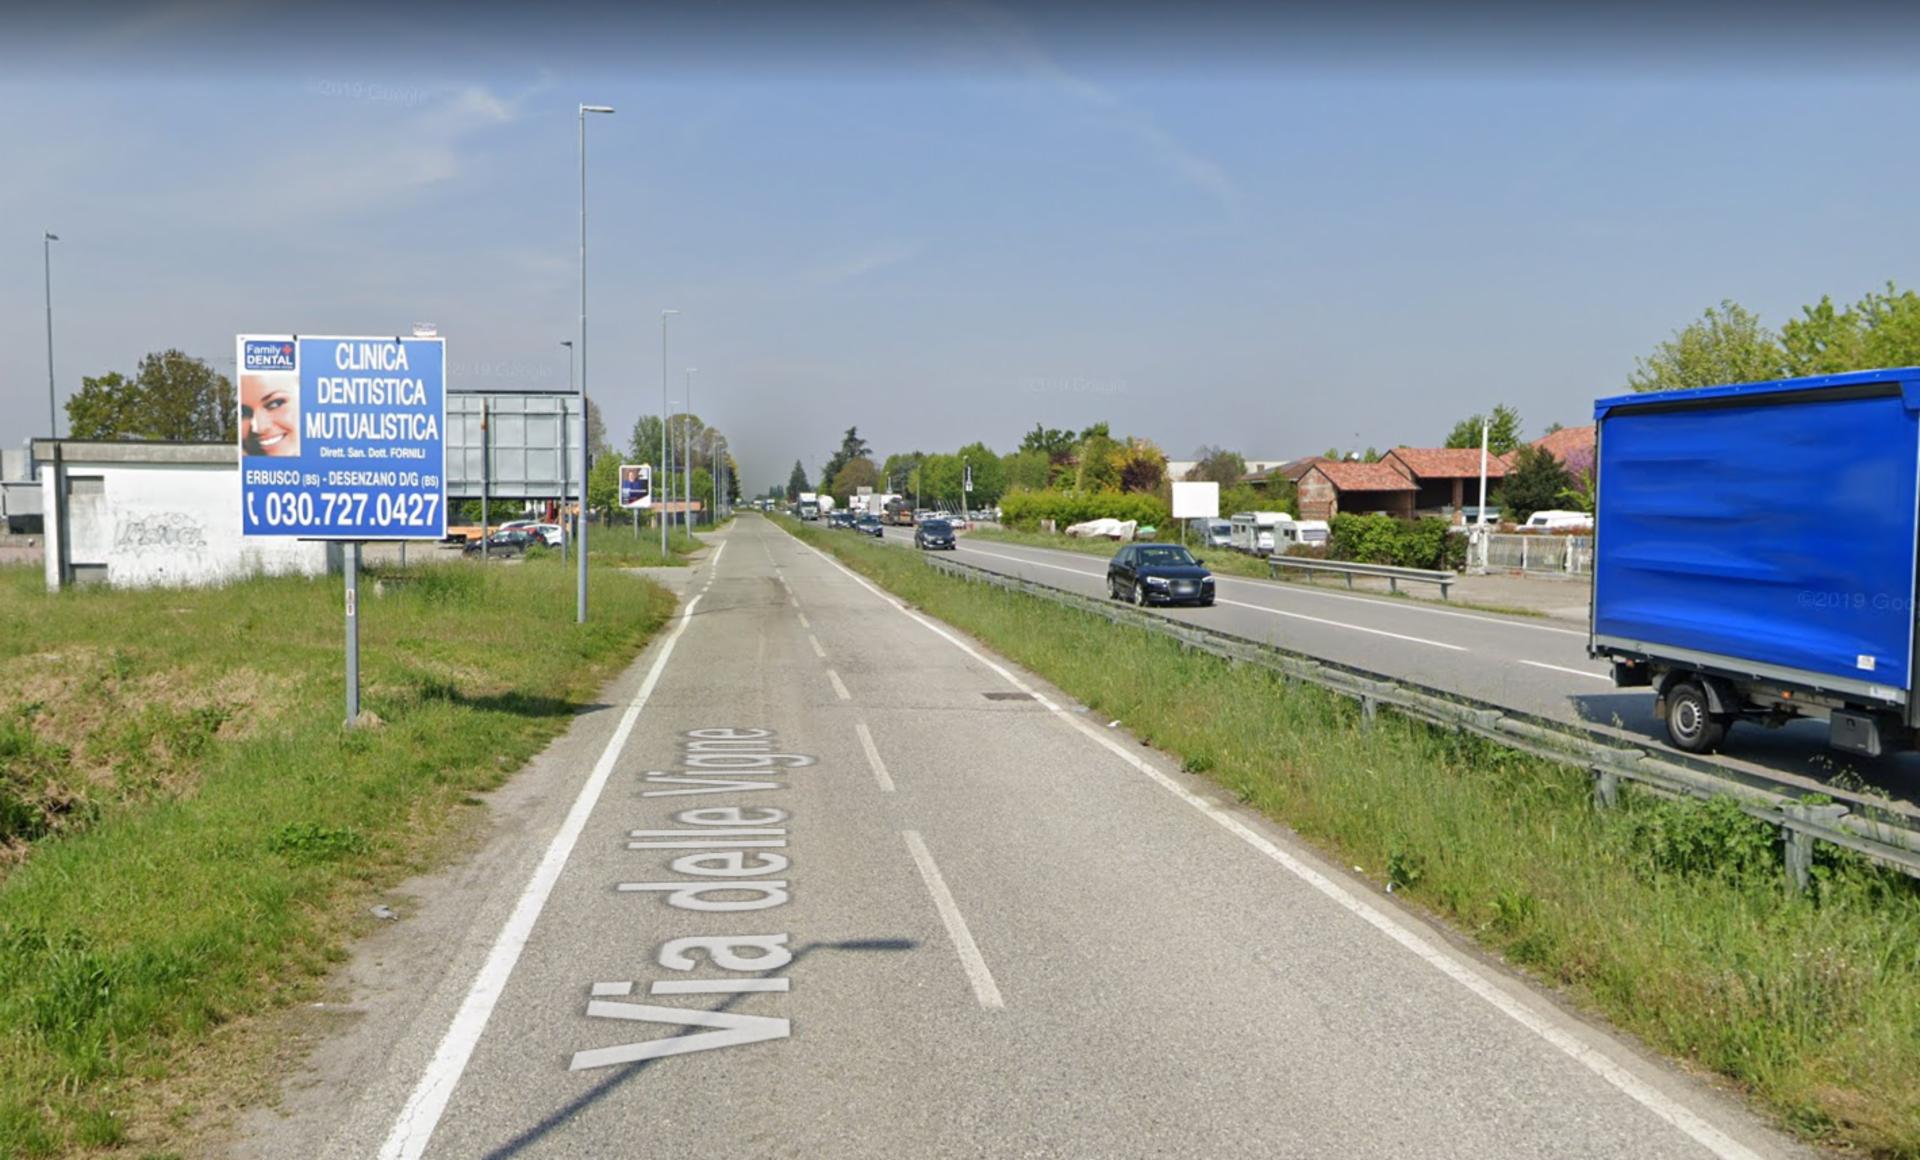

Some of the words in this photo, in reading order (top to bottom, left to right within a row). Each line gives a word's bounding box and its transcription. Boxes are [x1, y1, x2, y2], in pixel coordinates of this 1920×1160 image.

[247, 344, 281, 355] Family
[247, 355, 293, 365] DENTAL
[335, 342, 409, 371] CLINICA
[317, 377, 427, 405] DENTISTICA
[306, 412, 438, 440] MUTUALISTICA
[347, 447, 366, 458] San.
[368, 447, 388, 458] Dott.
[390, 448, 426, 459] FORNILI
[246, 470, 300, 486] ERBUSCO
[302, 473, 320, 488] (BS)
[328, 471, 397, 487] DESENZANO
[399, 471, 418, 487] D/G
[421, 474, 439, 489] (BS)
[265, 491, 439, 527] 030.727.0427
